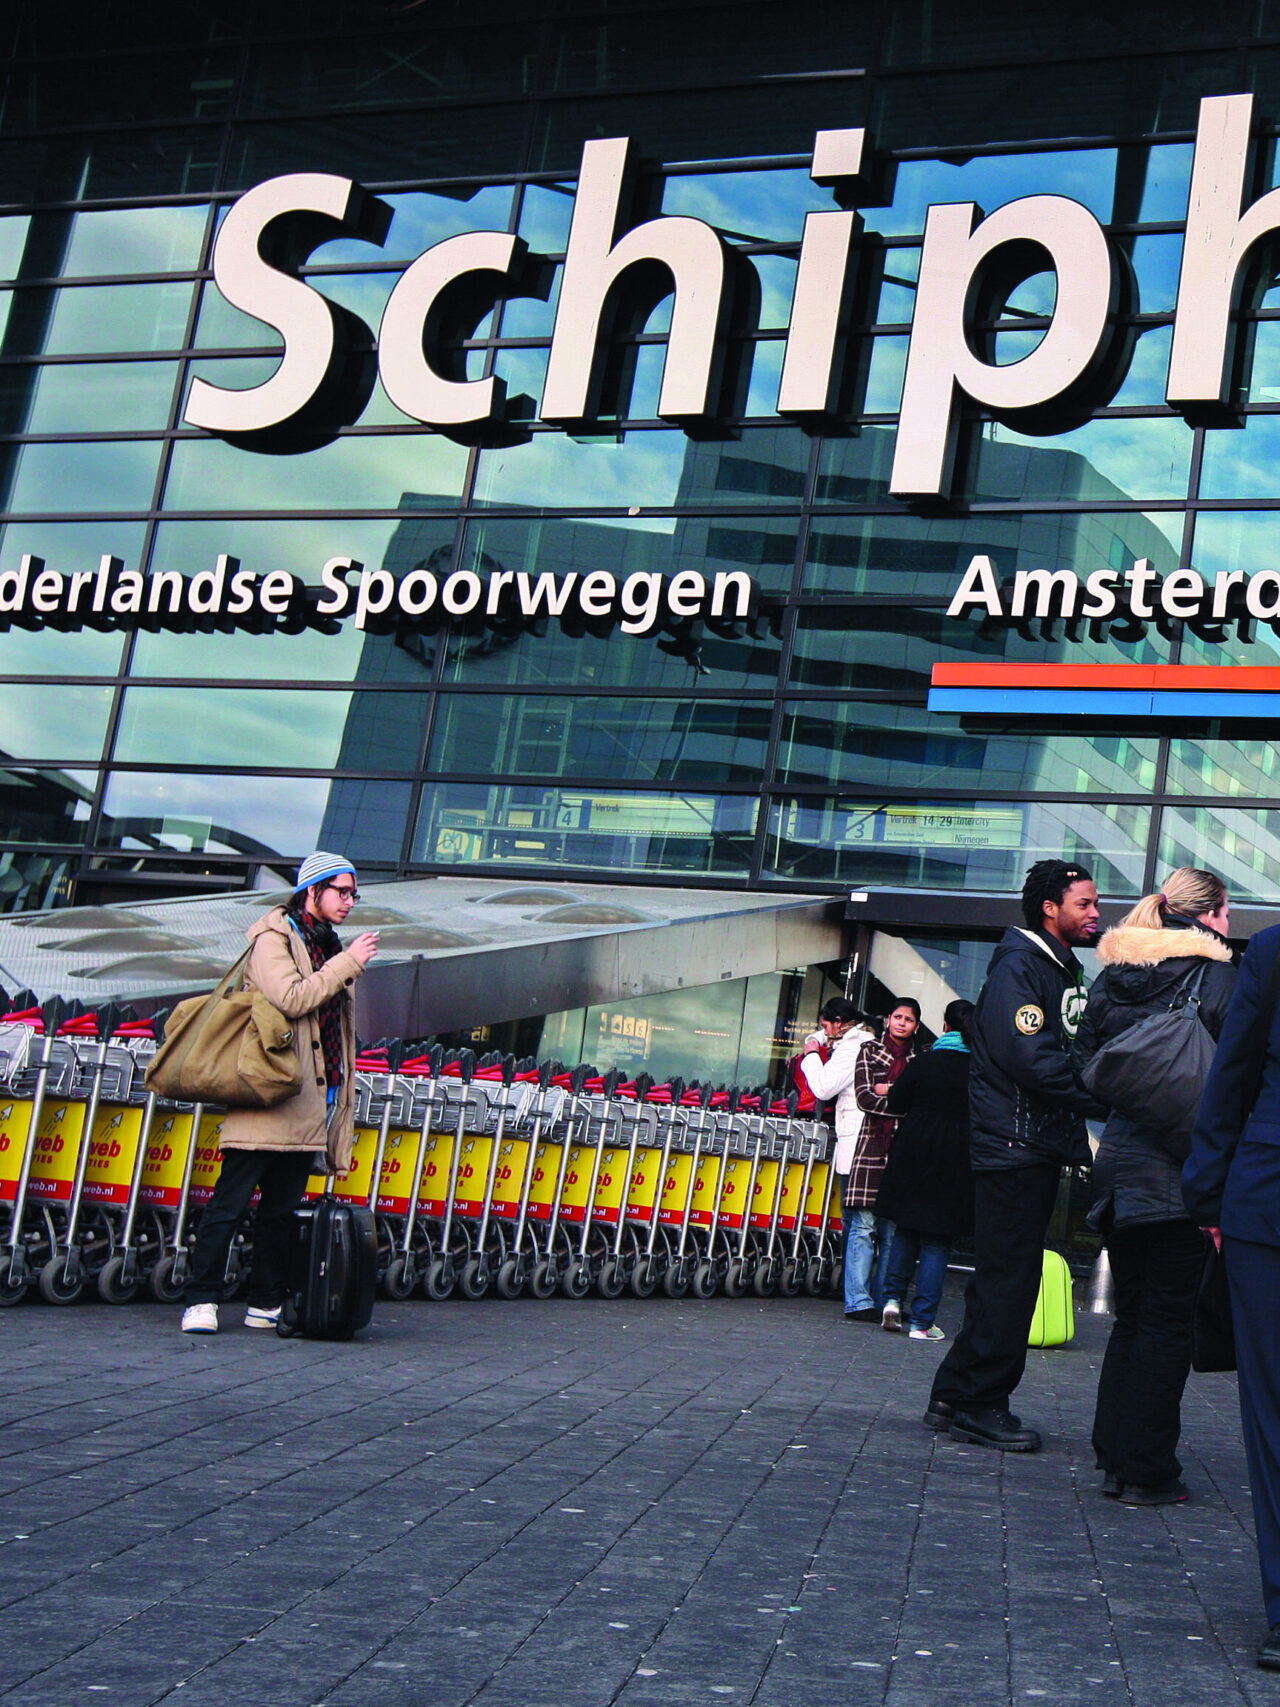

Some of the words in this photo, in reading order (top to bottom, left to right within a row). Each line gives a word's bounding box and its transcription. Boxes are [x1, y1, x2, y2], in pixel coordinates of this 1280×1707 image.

[0, 553, 294, 615] derlandse
[317, 556, 753, 635] Spoorwegen
[562, 811, 572, 825] 4
[922, 815, 934, 827] 14
[939, 816, 952, 827] 29
[955, 816, 990, 827] Intercity
[855, 822, 865, 839] 3
[1021, 1011, 1039, 1027] 72
